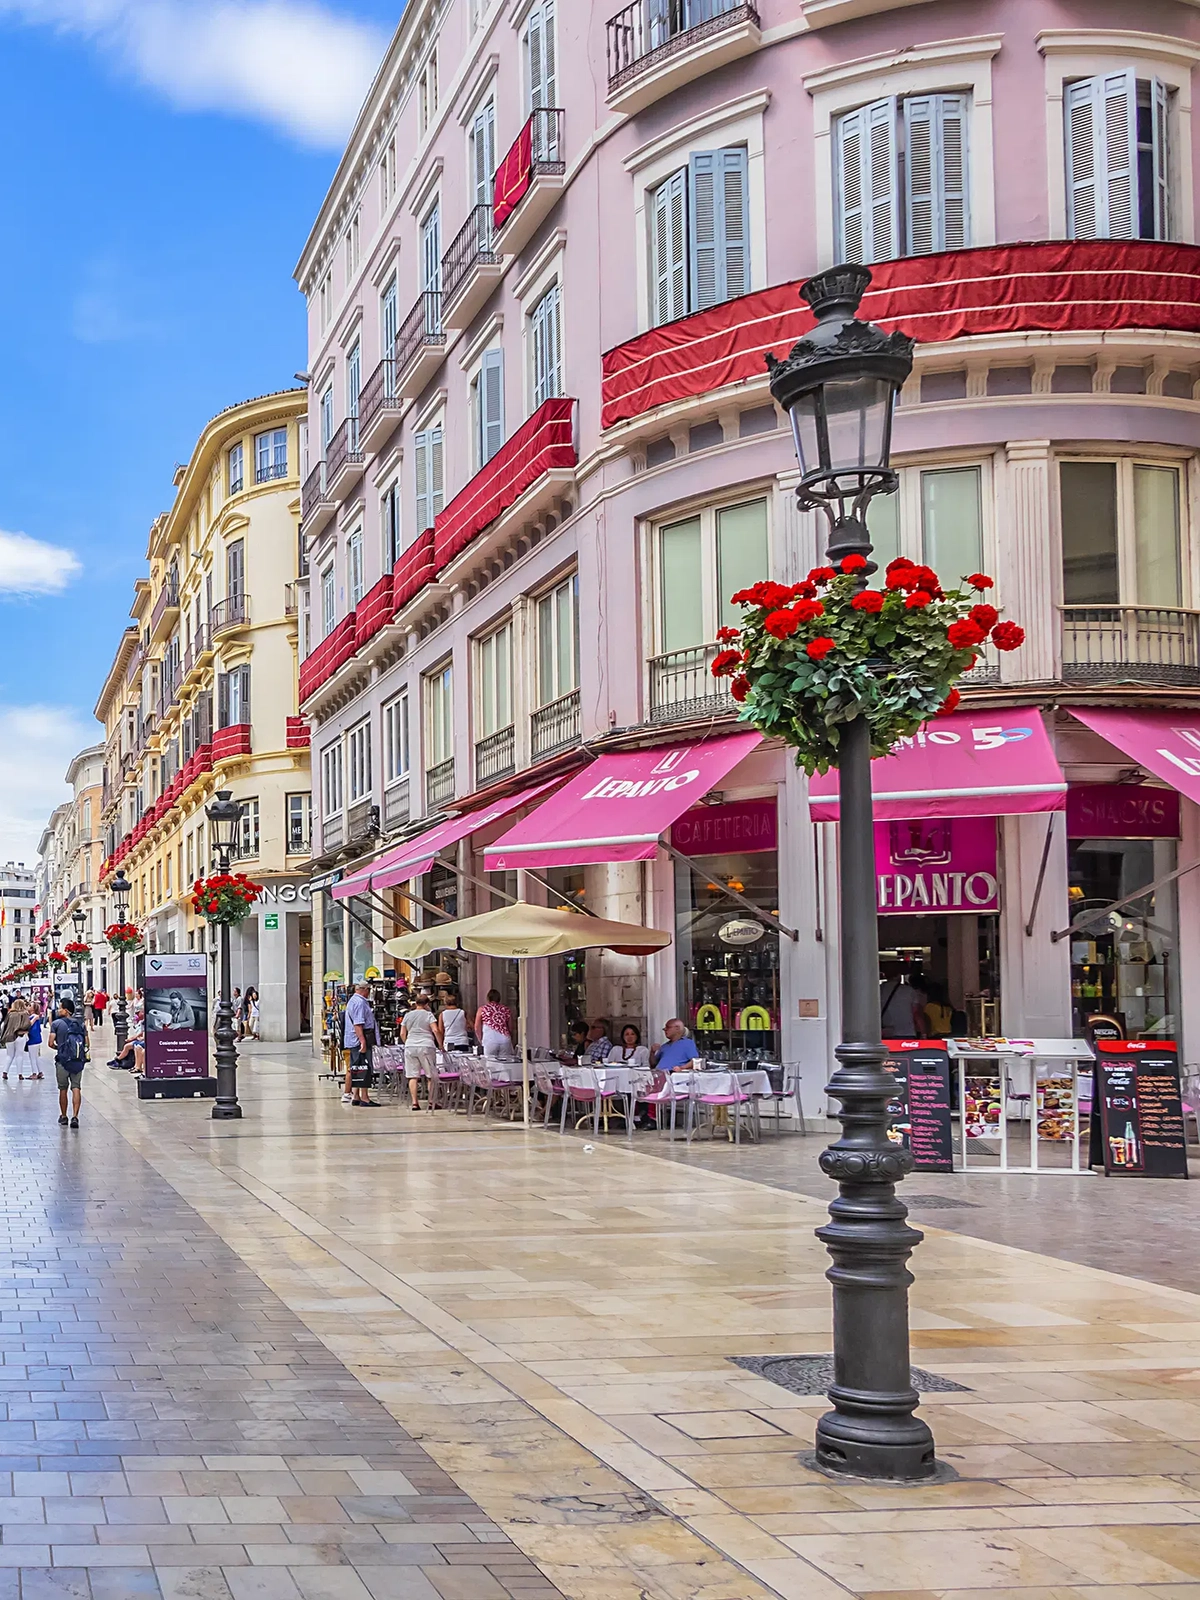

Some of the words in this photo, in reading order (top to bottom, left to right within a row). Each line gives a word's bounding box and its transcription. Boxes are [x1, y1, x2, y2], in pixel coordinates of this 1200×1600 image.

[580, 769, 700, 800] LEPANTO
[1080, 800, 1165, 824] SNACKS
[675, 813, 771, 844] CAFETERIA
[254, 883, 312, 903] NGO
[877, 871, 997, 907] EPANTO
